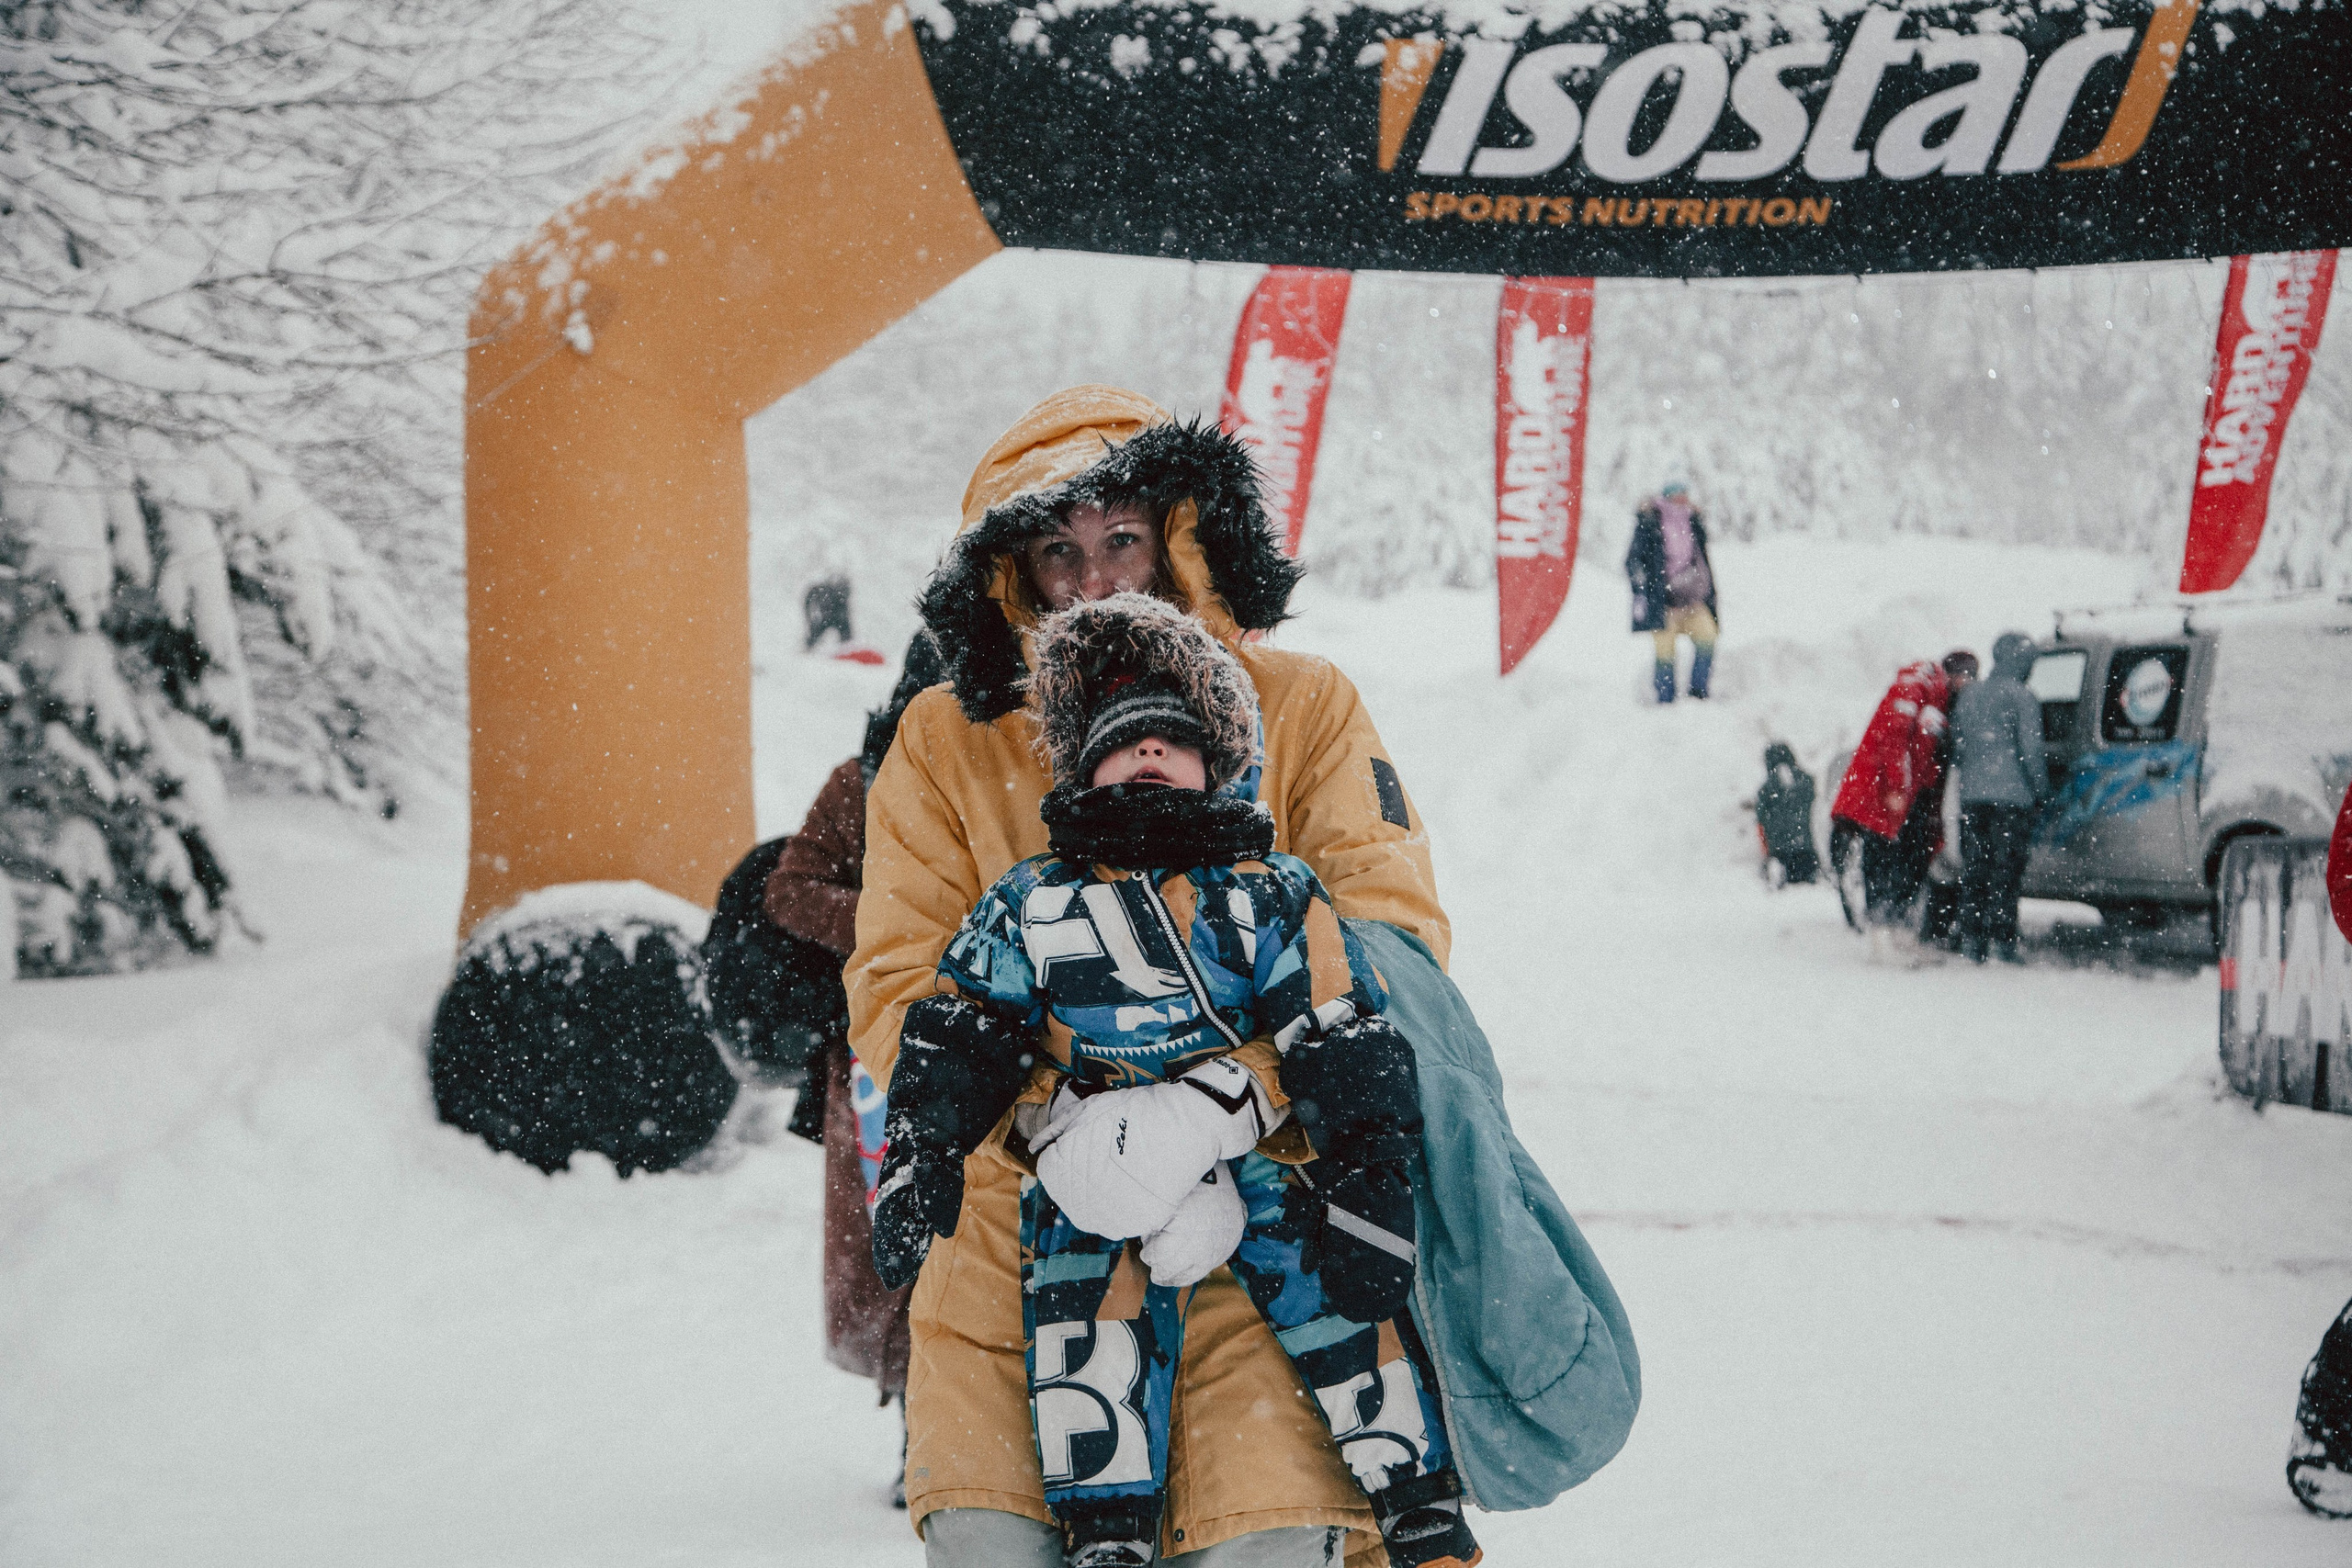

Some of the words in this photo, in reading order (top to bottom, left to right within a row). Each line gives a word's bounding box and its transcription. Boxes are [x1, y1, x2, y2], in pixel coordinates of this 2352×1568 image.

[1404, 191, 1575, 225] SPORTS
[1580, 196, 1834, 228] NUTRITION
[2200, 333, 2267, 486] HARD
[1497, 413, 1550, 558] HARD
[1116, 1117, 1127, 1156] Leki
